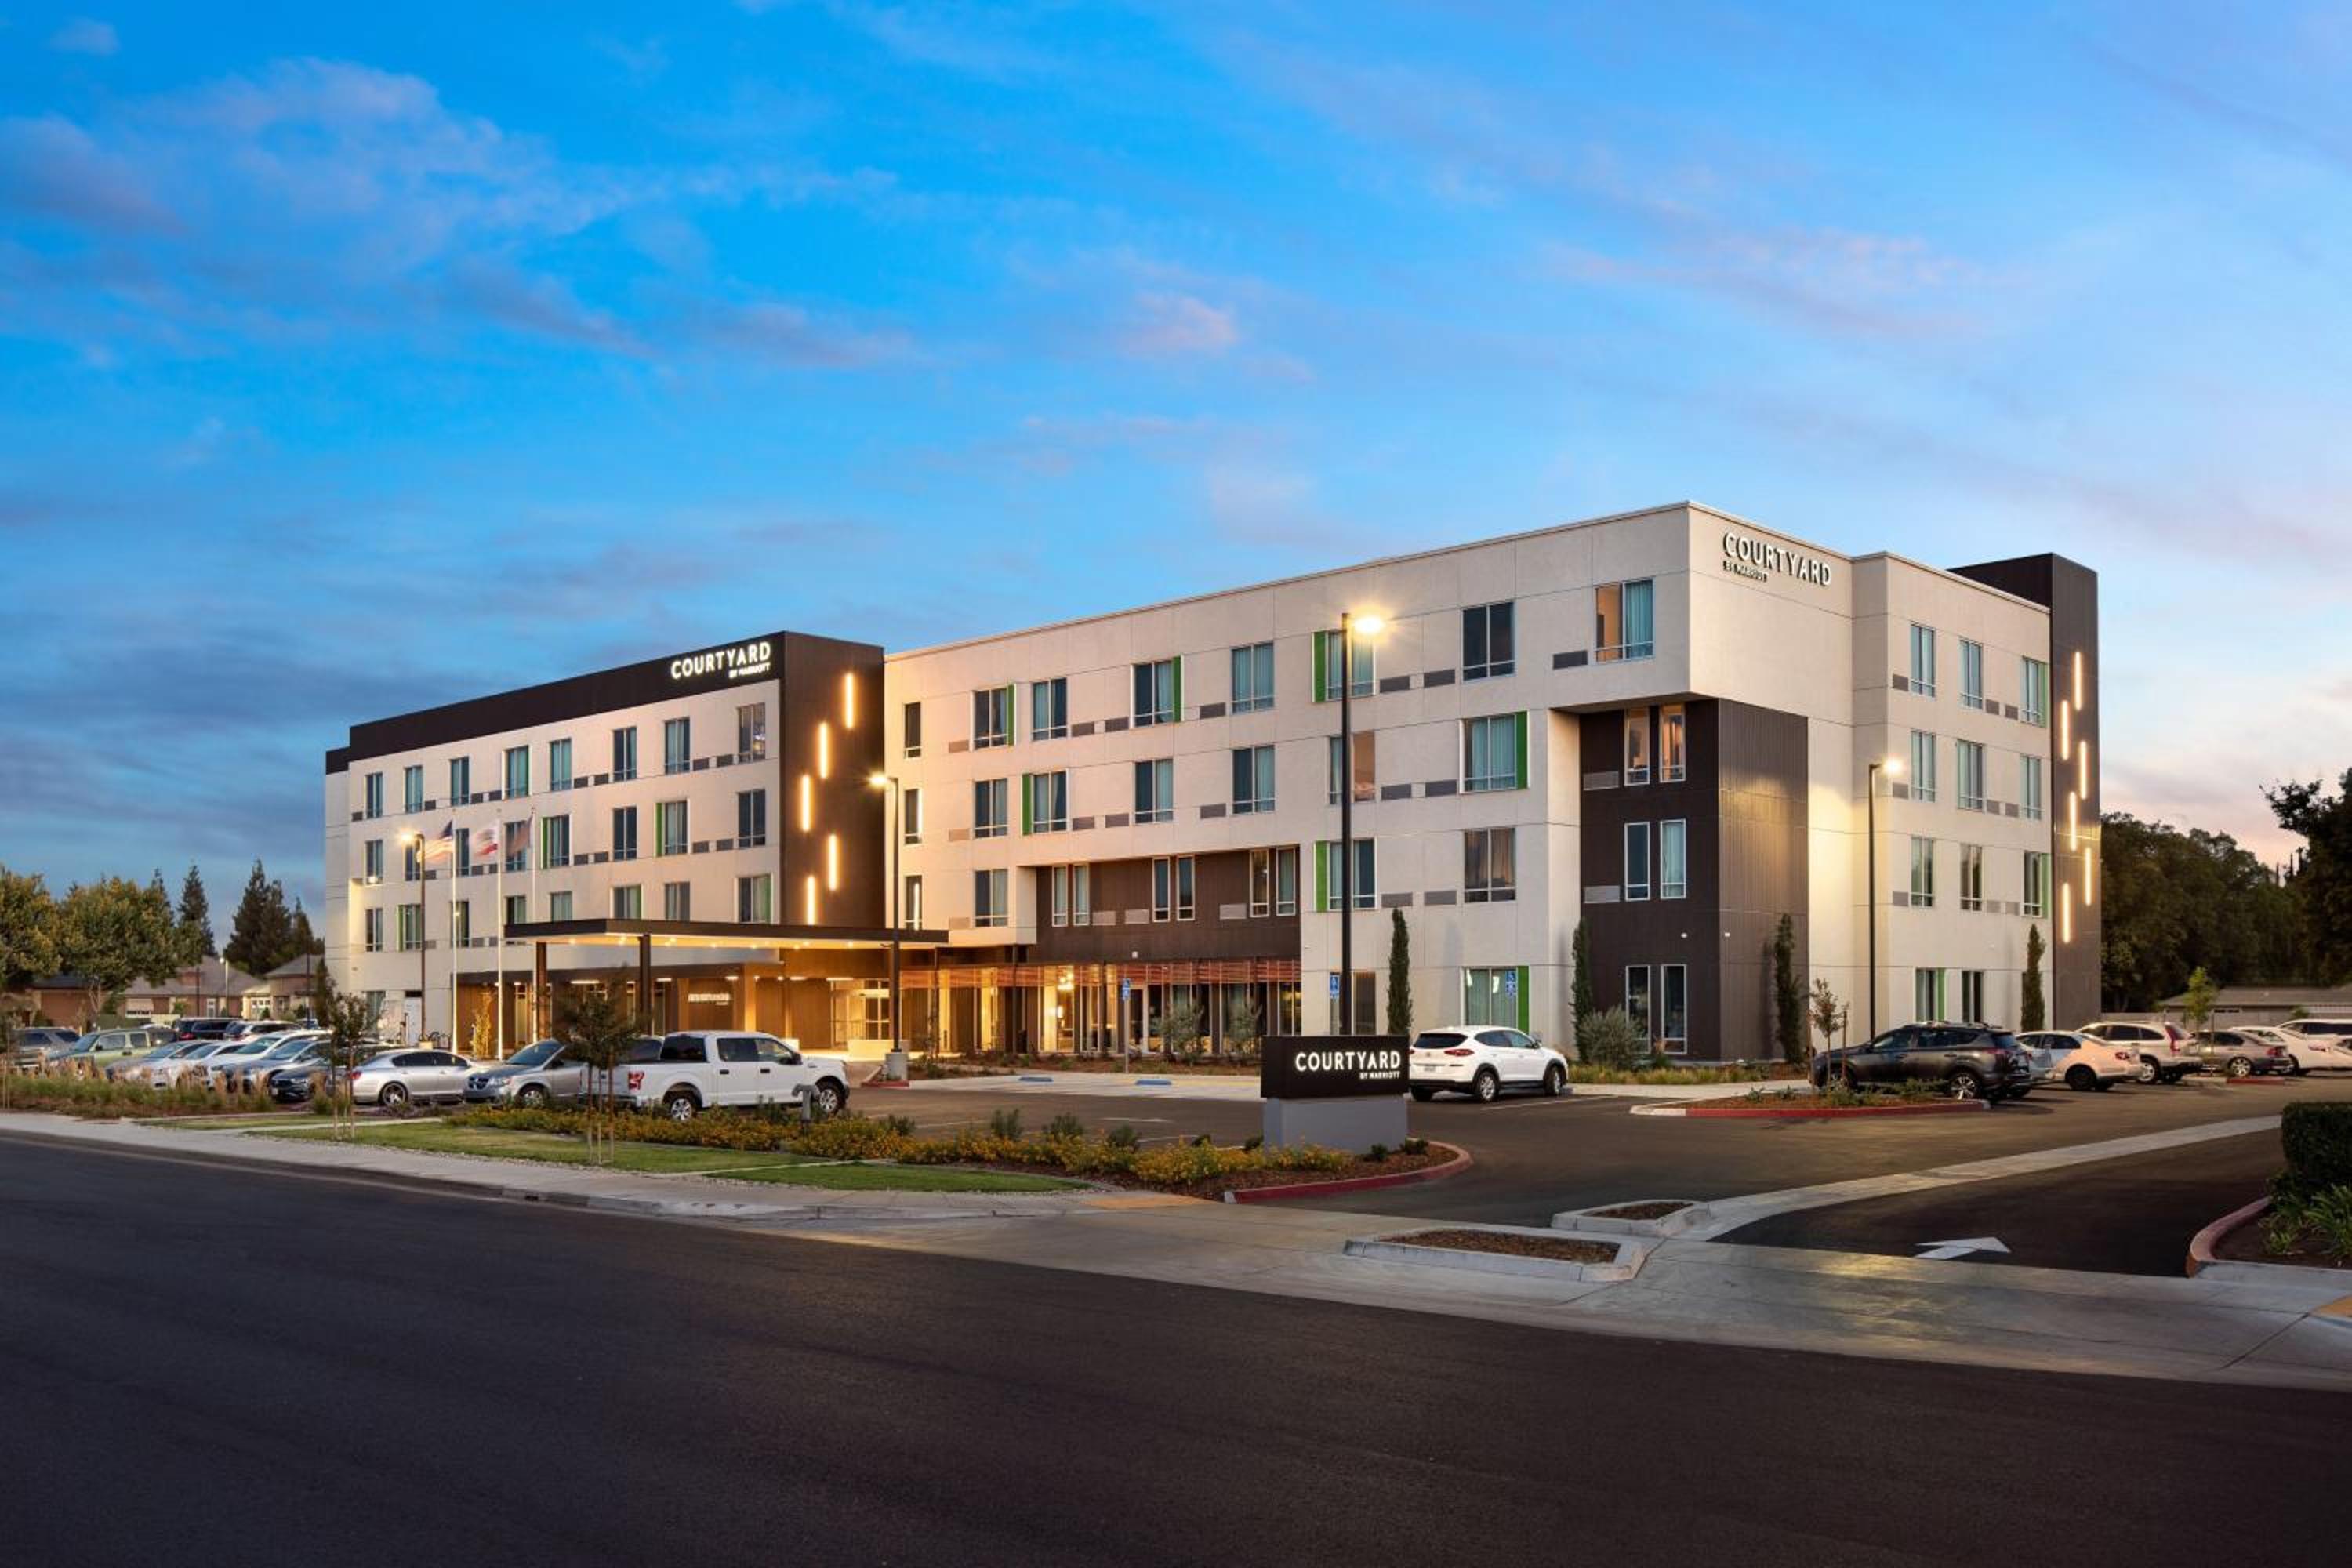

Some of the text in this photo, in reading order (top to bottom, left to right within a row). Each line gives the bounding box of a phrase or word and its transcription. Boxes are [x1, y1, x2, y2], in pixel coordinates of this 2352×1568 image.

[1723, 532, 1831, 586] COURTYARD
[671, 642, 771, 679] COURTYARD
[1295, 1051, 1401, 1072] COURTYARD
